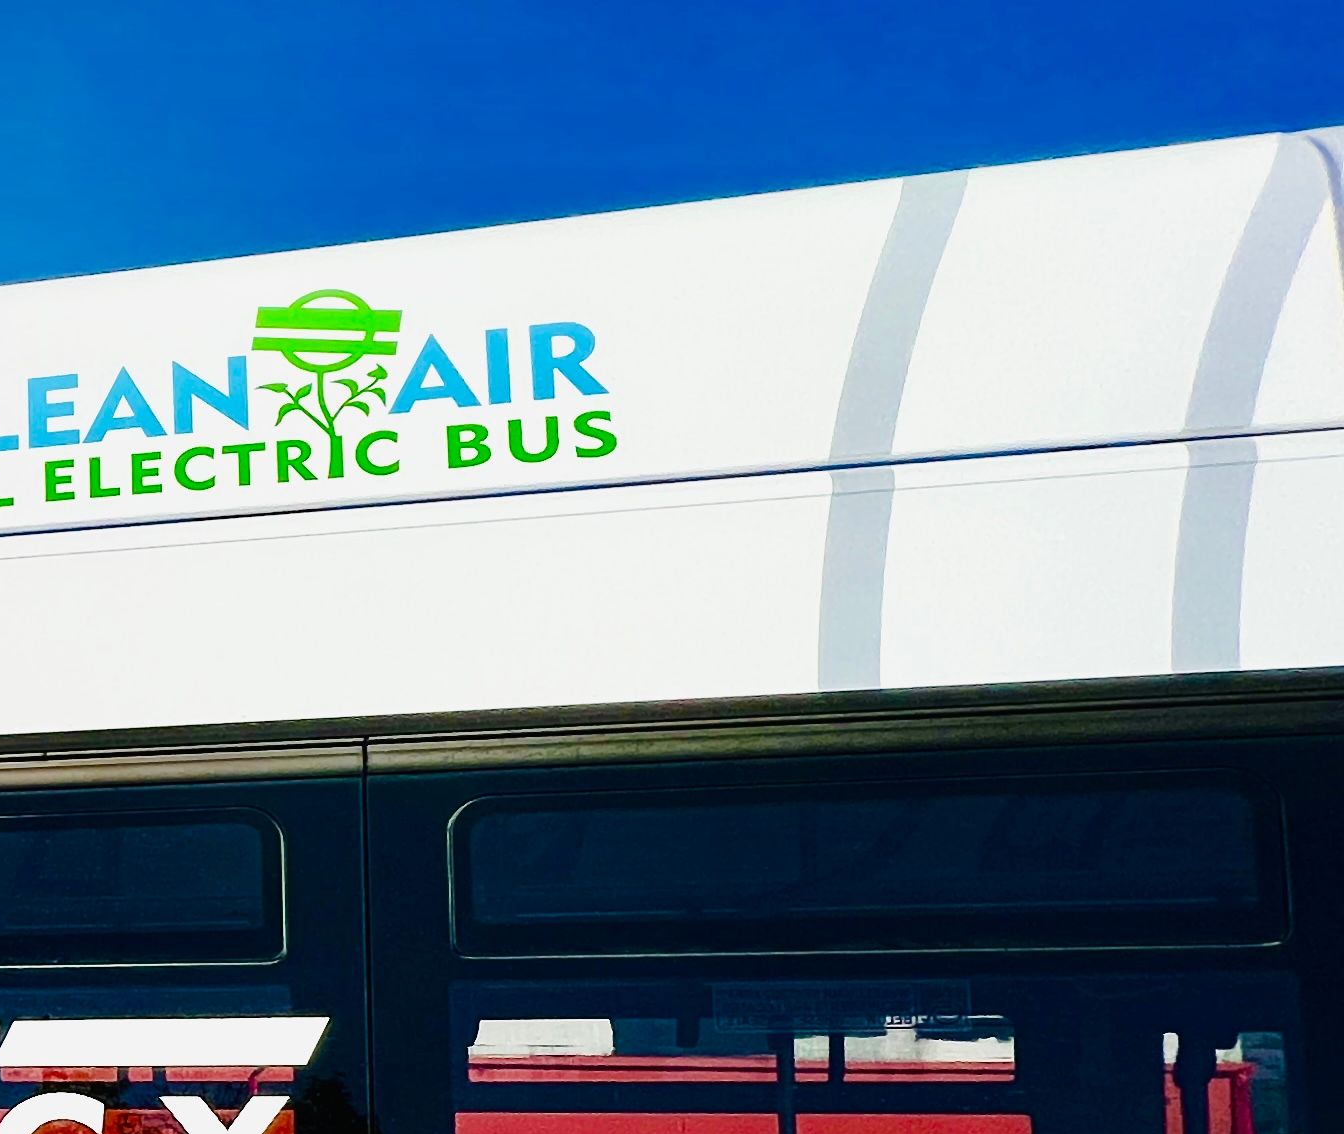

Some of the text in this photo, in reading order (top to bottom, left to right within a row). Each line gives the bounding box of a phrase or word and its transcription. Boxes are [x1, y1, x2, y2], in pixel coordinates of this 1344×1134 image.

[389, 321, 609, 415] AIR
[44, 430, 400, 502] ELECTRIC
[446, 409, 618, 470] BUS
